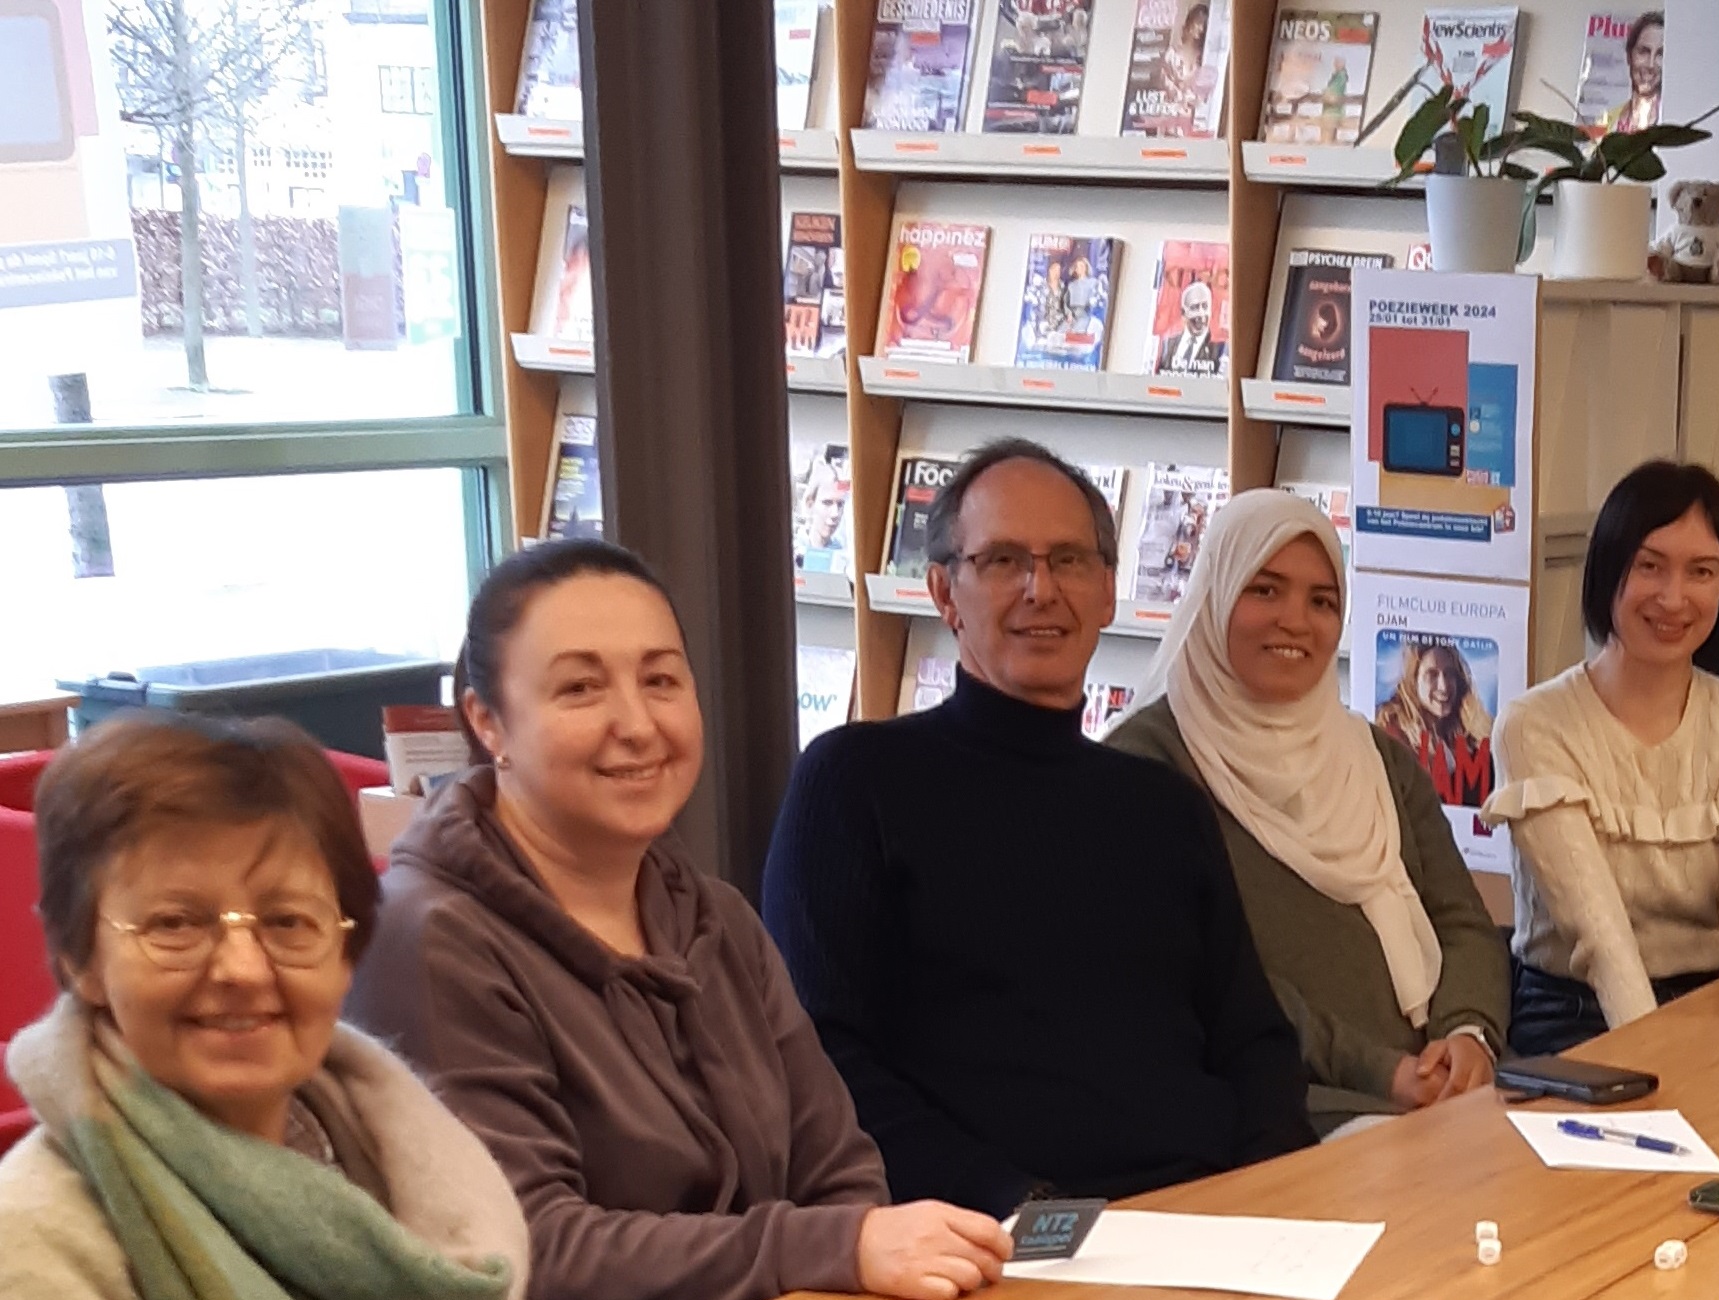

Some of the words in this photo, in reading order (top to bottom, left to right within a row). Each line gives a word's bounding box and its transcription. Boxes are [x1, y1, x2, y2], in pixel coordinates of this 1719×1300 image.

[1280, 19, 1332, 43] NEOS
[1587, 15, 1632, 39] Plu
[899, 226, 987, 249] happinez
[1368, 299, 1459, 317] POEZIEWEEK
[1463, 304, 1497, 319] 2024
[1401, 316, 1417, 326] tot
[1420, 316, 1451, 327] 31/01
[1189, 358, 1215, 371] man
[1376, 593, 1447, 617] FILMCLUB
[1451, 600, 1507, 619] EUROPA
[1376, 613, 1408, 628] DJAM
